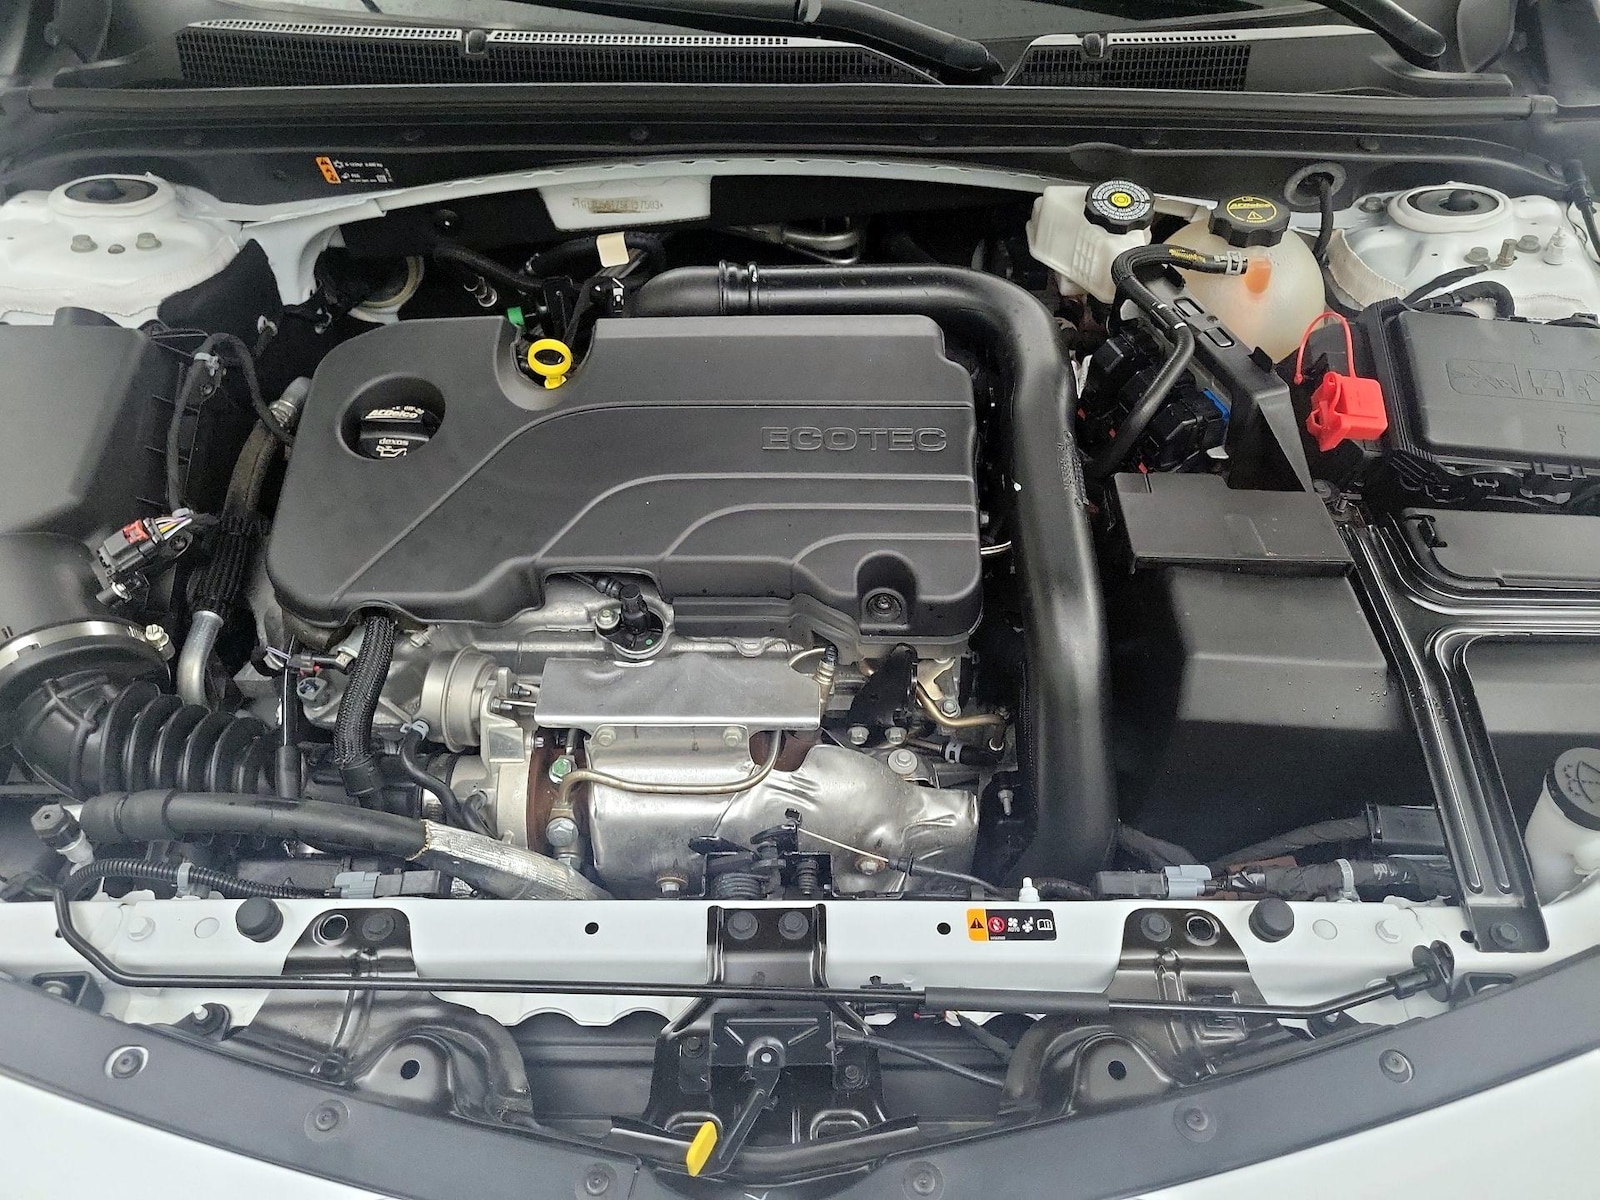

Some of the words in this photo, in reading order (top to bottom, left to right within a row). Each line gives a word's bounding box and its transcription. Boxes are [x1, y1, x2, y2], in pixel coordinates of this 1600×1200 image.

[365, 409, 418, 419] ACDelco
[379, 437, 409, 446] dexos
[761, 426, 947, 452] ECOTEC
